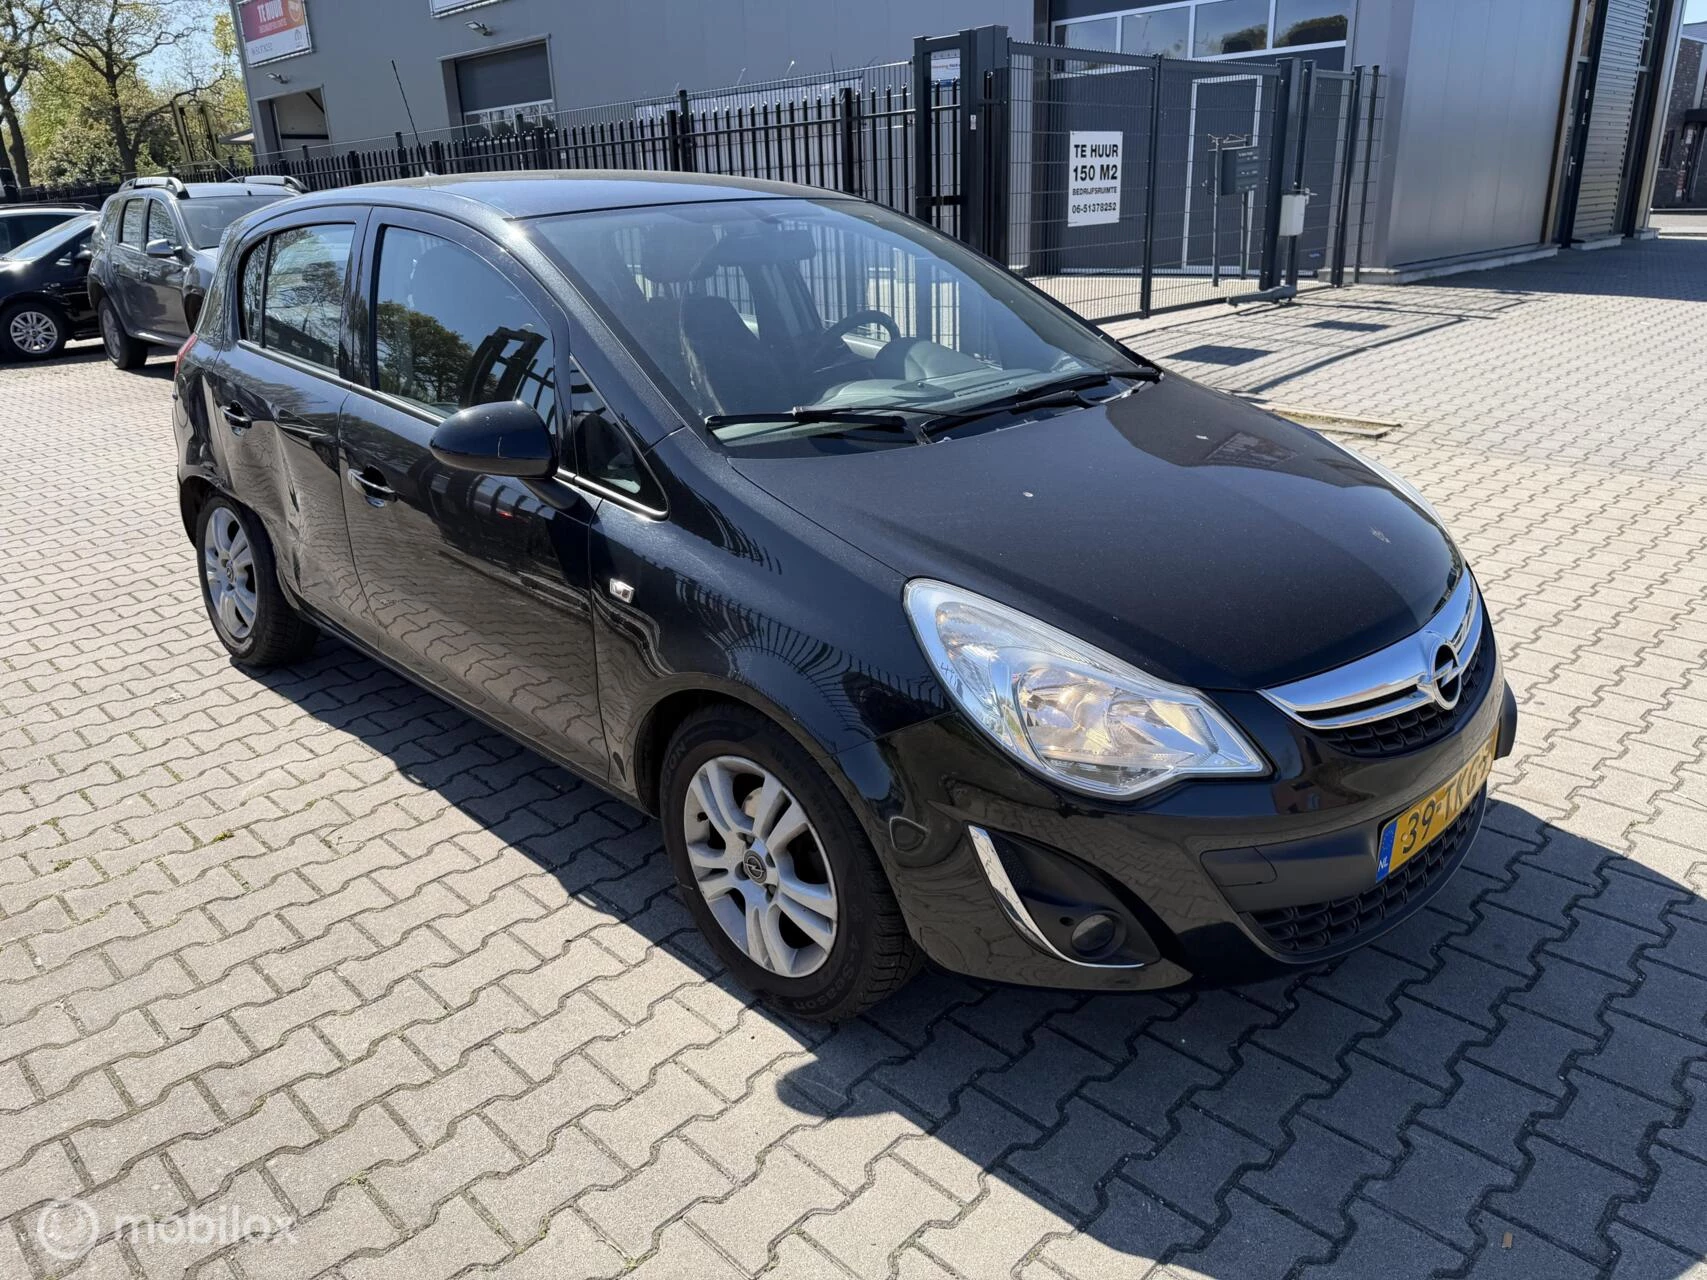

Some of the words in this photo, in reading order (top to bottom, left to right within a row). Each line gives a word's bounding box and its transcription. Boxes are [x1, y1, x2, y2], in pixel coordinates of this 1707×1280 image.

[1073, 144, 1087, 158] TE
[1090, 144, 1119, 158] HUUR
[1073, 165, 1096, 182] 150
[1099, 164, 1118, 181] M2
[1072, 186, 1118, 196] BEDRIJFSRUIMTE
[1072, 202, 1117, 214] 06-51378252
